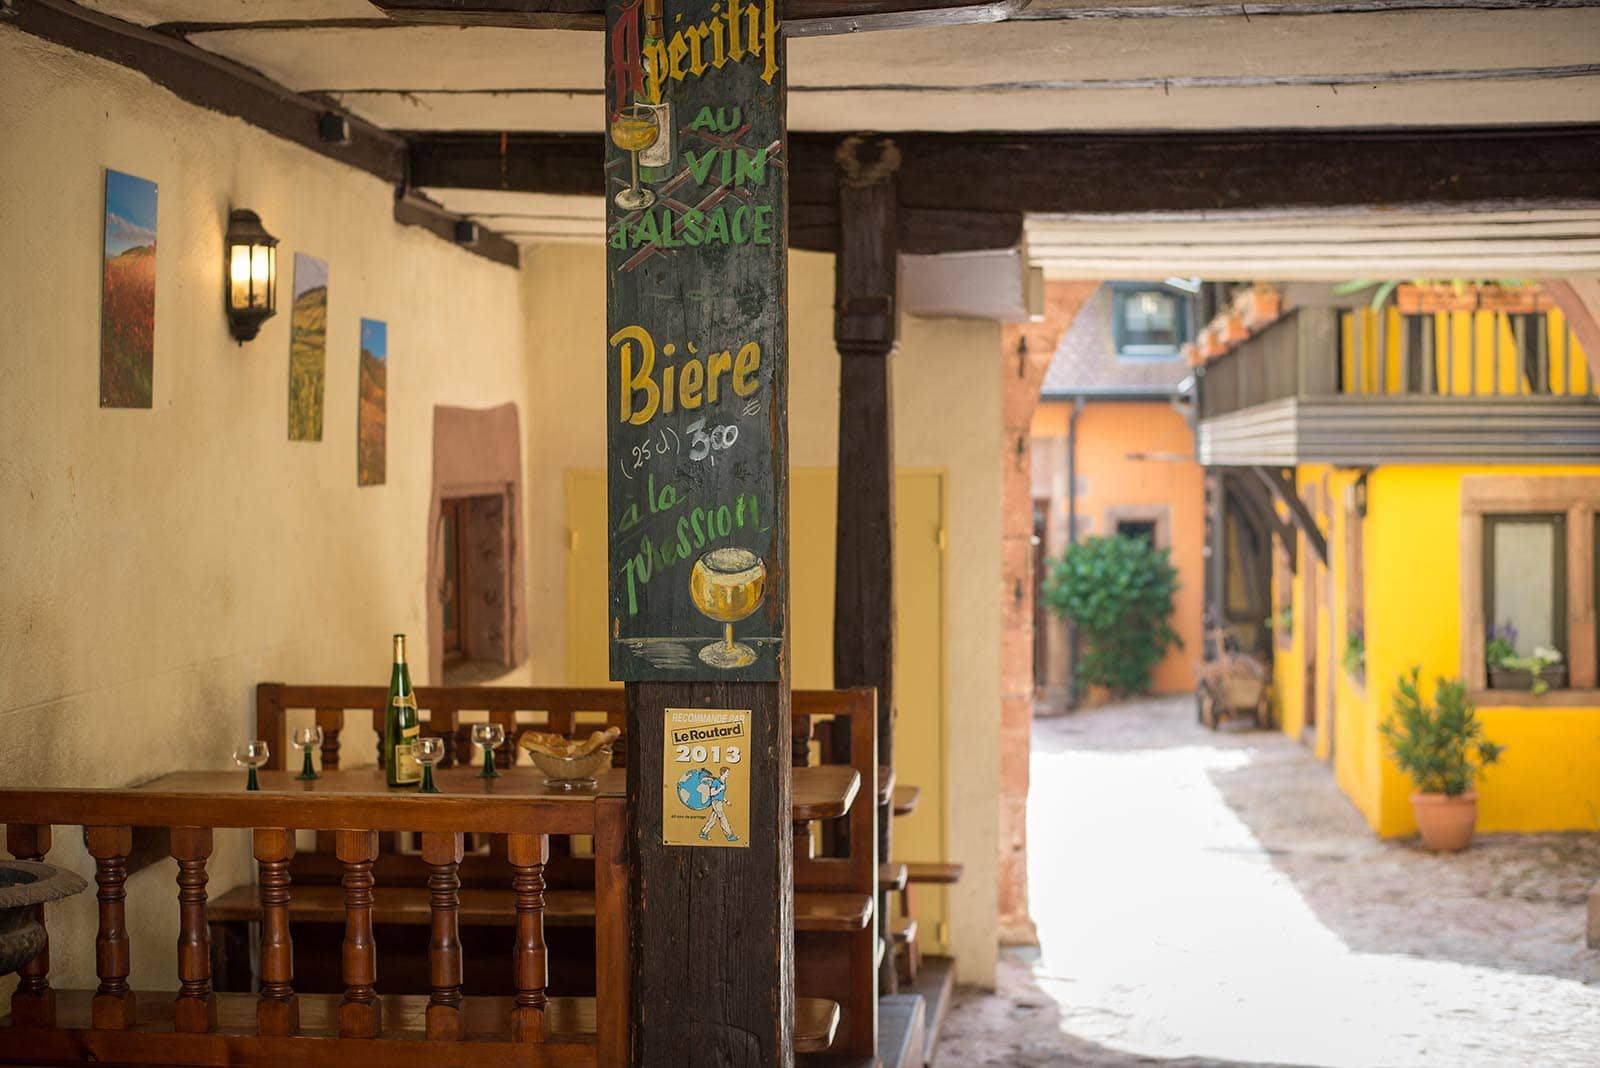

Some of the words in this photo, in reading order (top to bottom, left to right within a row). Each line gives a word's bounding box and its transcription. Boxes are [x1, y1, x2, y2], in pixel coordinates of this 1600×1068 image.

[690, 106, 741, 132] AU
[684, 148, 767, 185] VIN
[610, 325, 761, 425] Bière
[649, 473, 686, 513] la
[675, 745, 742, 765] 2013
